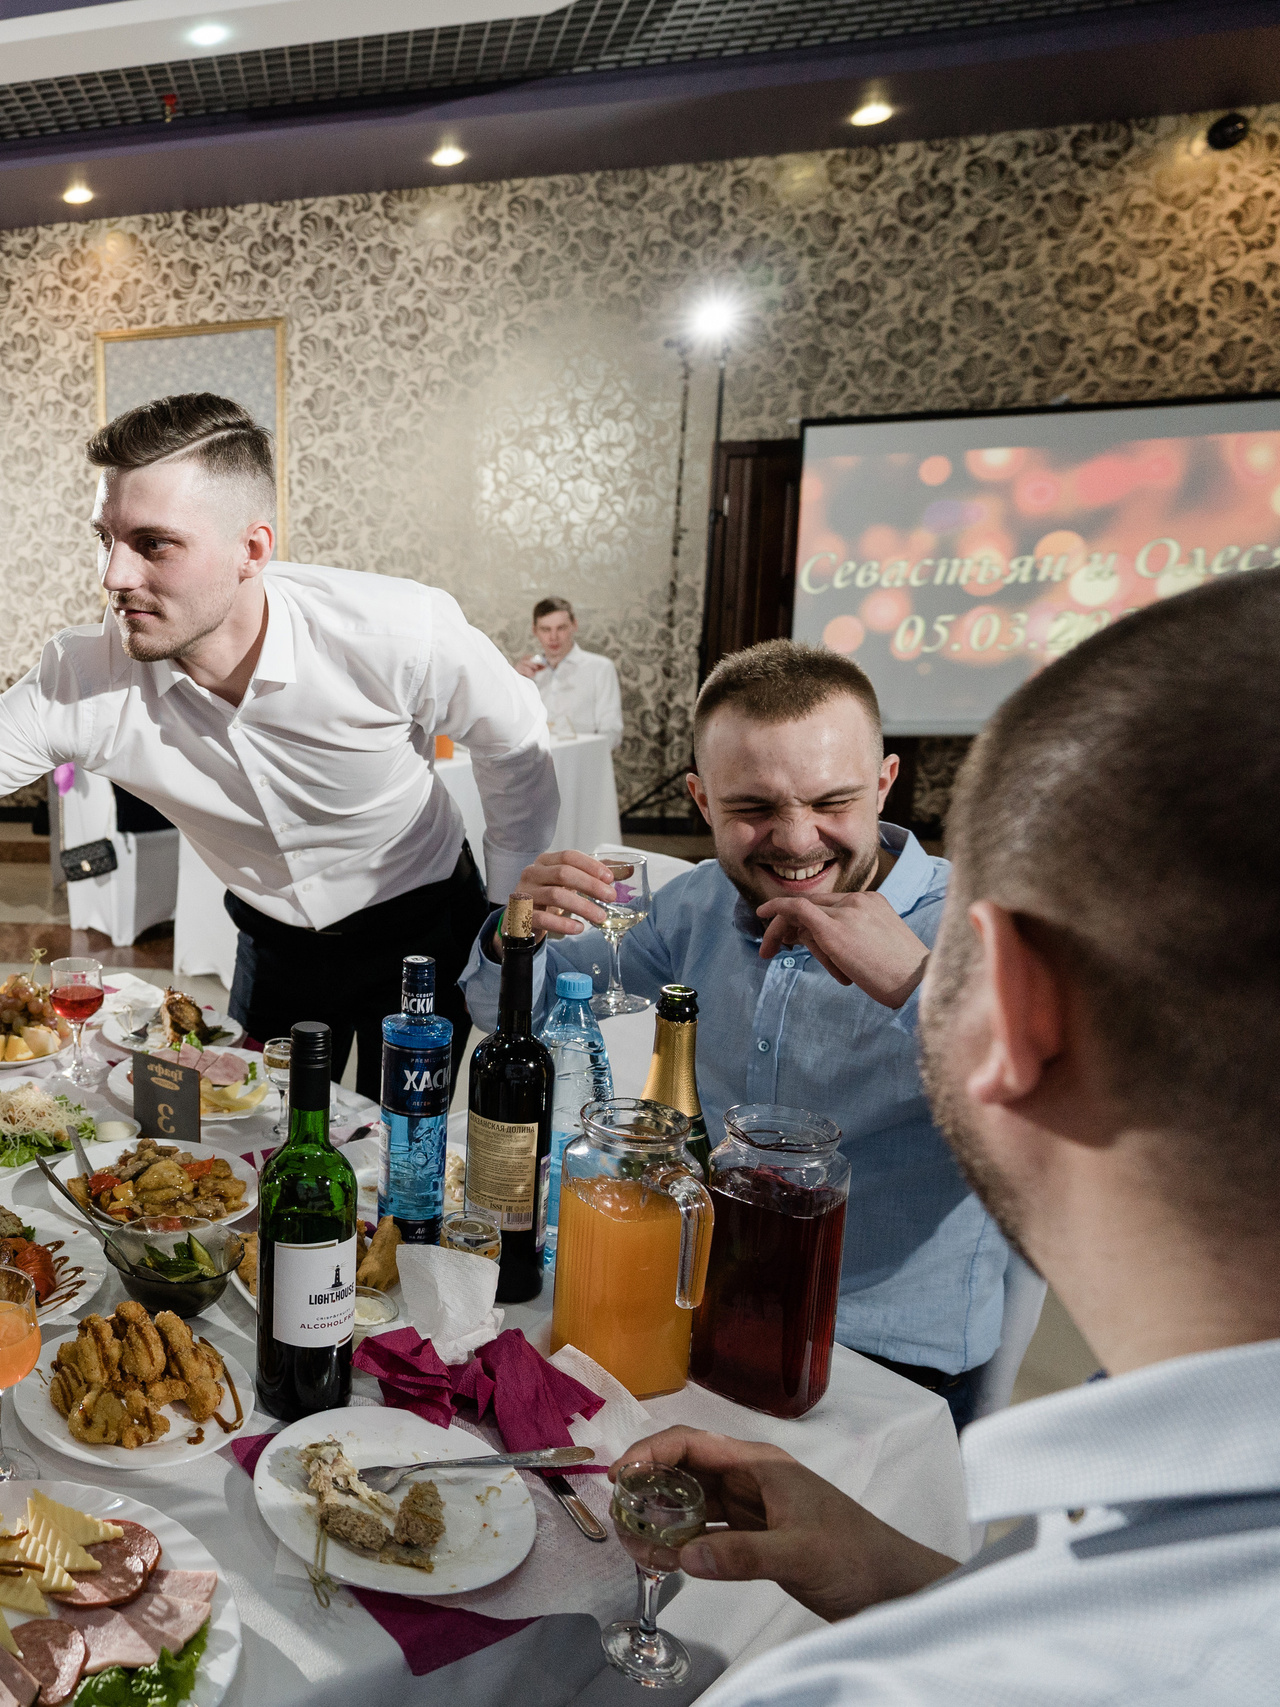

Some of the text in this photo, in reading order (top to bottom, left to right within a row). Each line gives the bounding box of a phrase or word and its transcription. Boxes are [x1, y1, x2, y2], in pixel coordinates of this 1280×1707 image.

[798, 552, 1069, 595] Севастьян
[1086, 552, 1119, 581] и
[506, 1125, 535, 1134] ДОЛИНА
